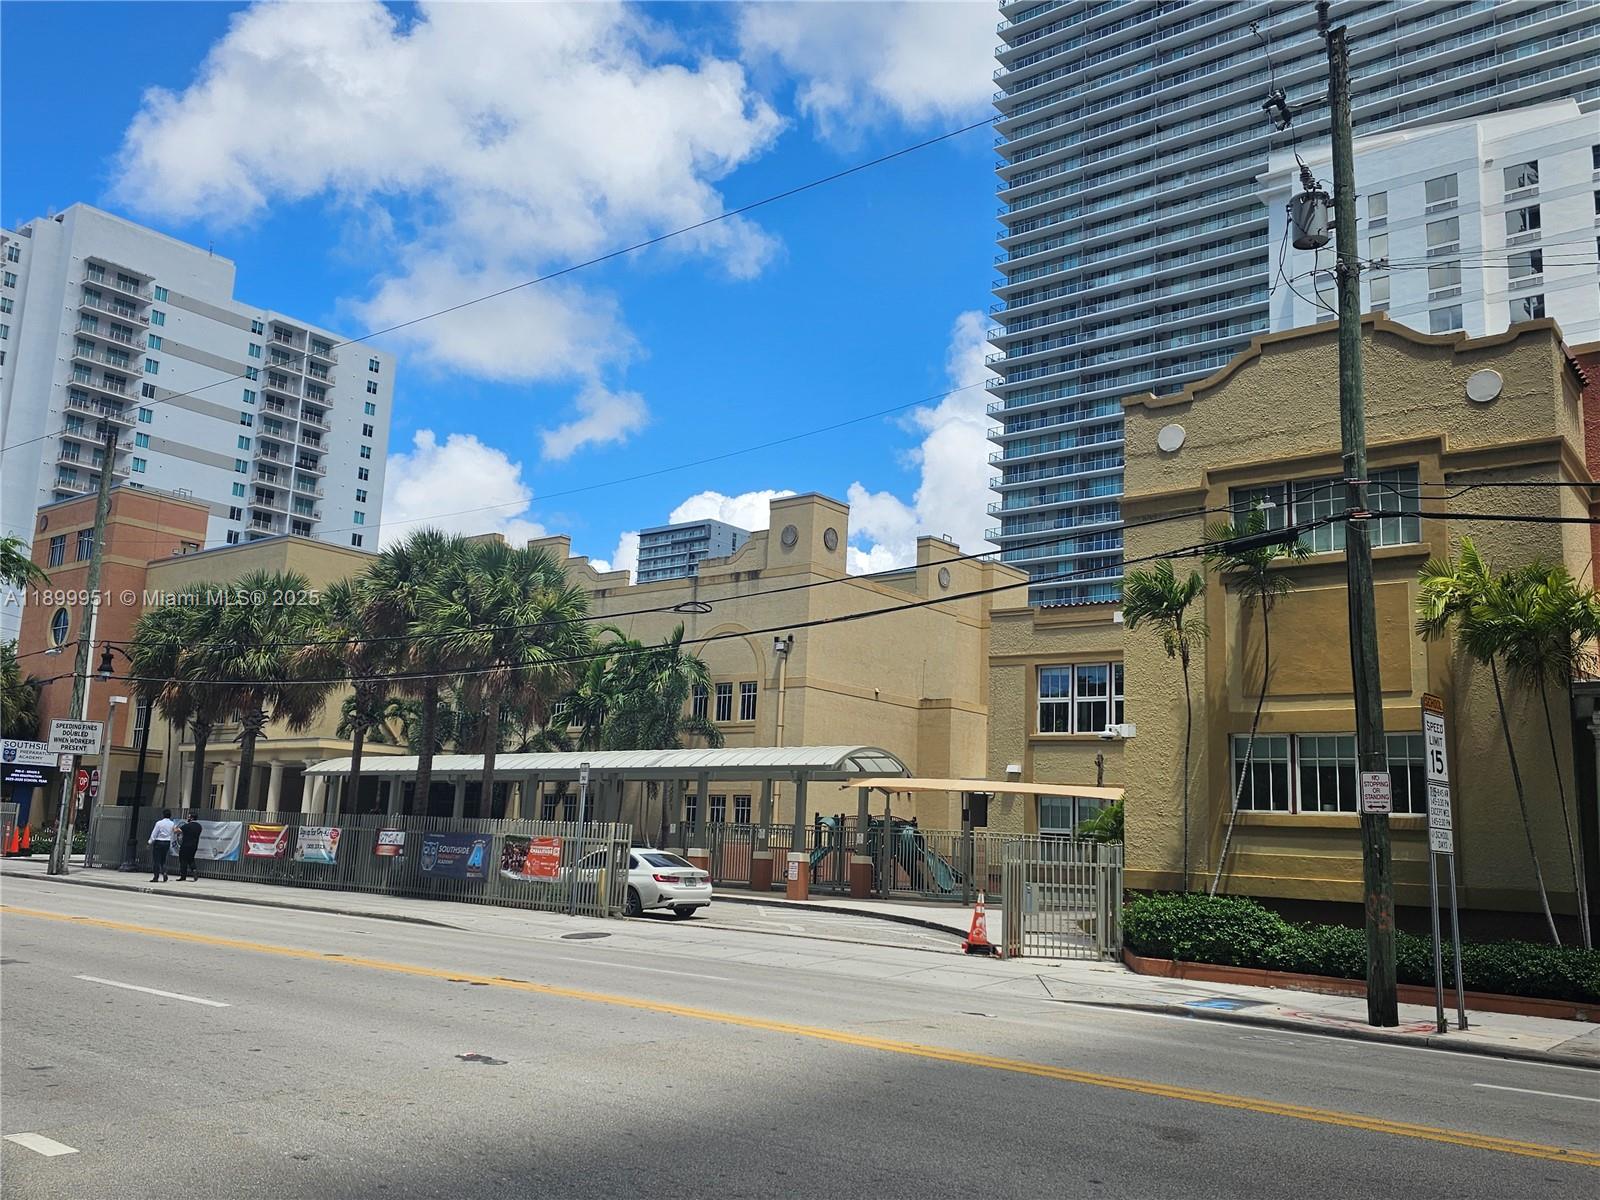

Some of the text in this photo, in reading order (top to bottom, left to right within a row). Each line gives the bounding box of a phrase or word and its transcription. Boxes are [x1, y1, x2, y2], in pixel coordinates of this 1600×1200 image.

[55, 722, 81, 730] SPEEDING
[1426, 720, 1443, 734] SPEED
[4, 740, 48, 750] SOUTHSI
[1429, 735, 1443, 747] LIMIT
[60, 744, 87, 752] PRESENT
[1430, 749, 1444, 775] 15
[438, 845, 471, 855] SOUTHSIDE
